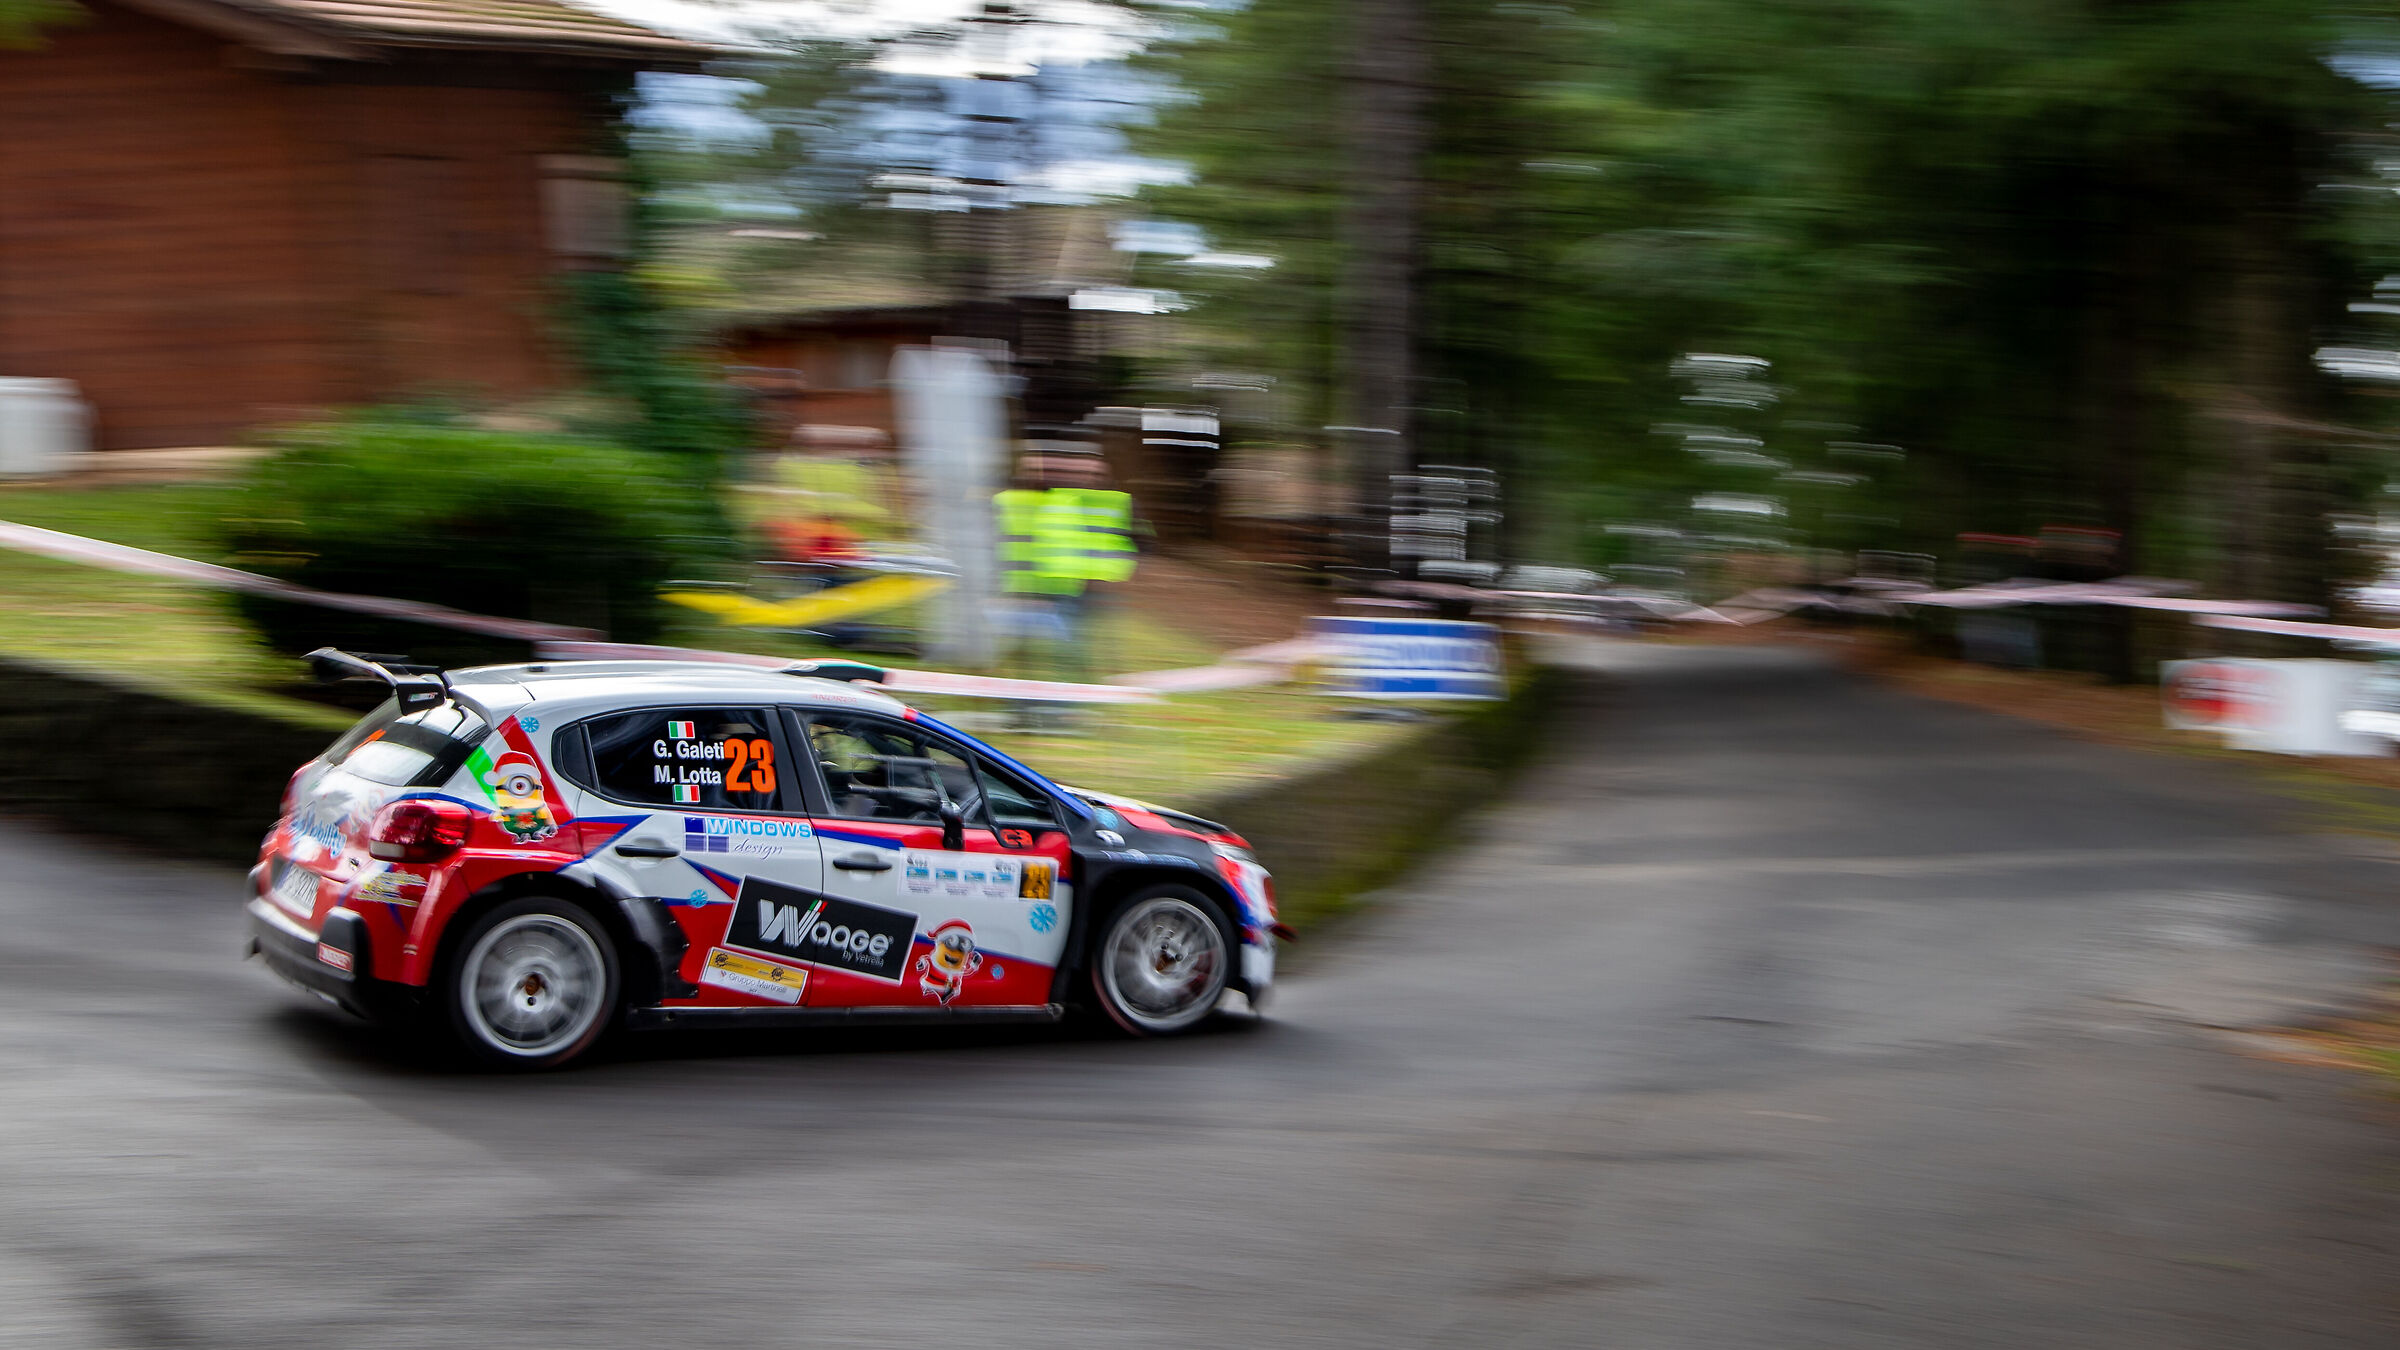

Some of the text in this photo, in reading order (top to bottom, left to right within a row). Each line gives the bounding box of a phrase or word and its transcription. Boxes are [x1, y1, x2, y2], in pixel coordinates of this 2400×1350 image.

[653, 739, 724, 760] G. Galeti
[653, 764, 722, 785] M. Lotta
[723, 738, 777, 793] 23
[706, 817, 811, 838] WINDOWS
[734, 838, 783, 860] design
